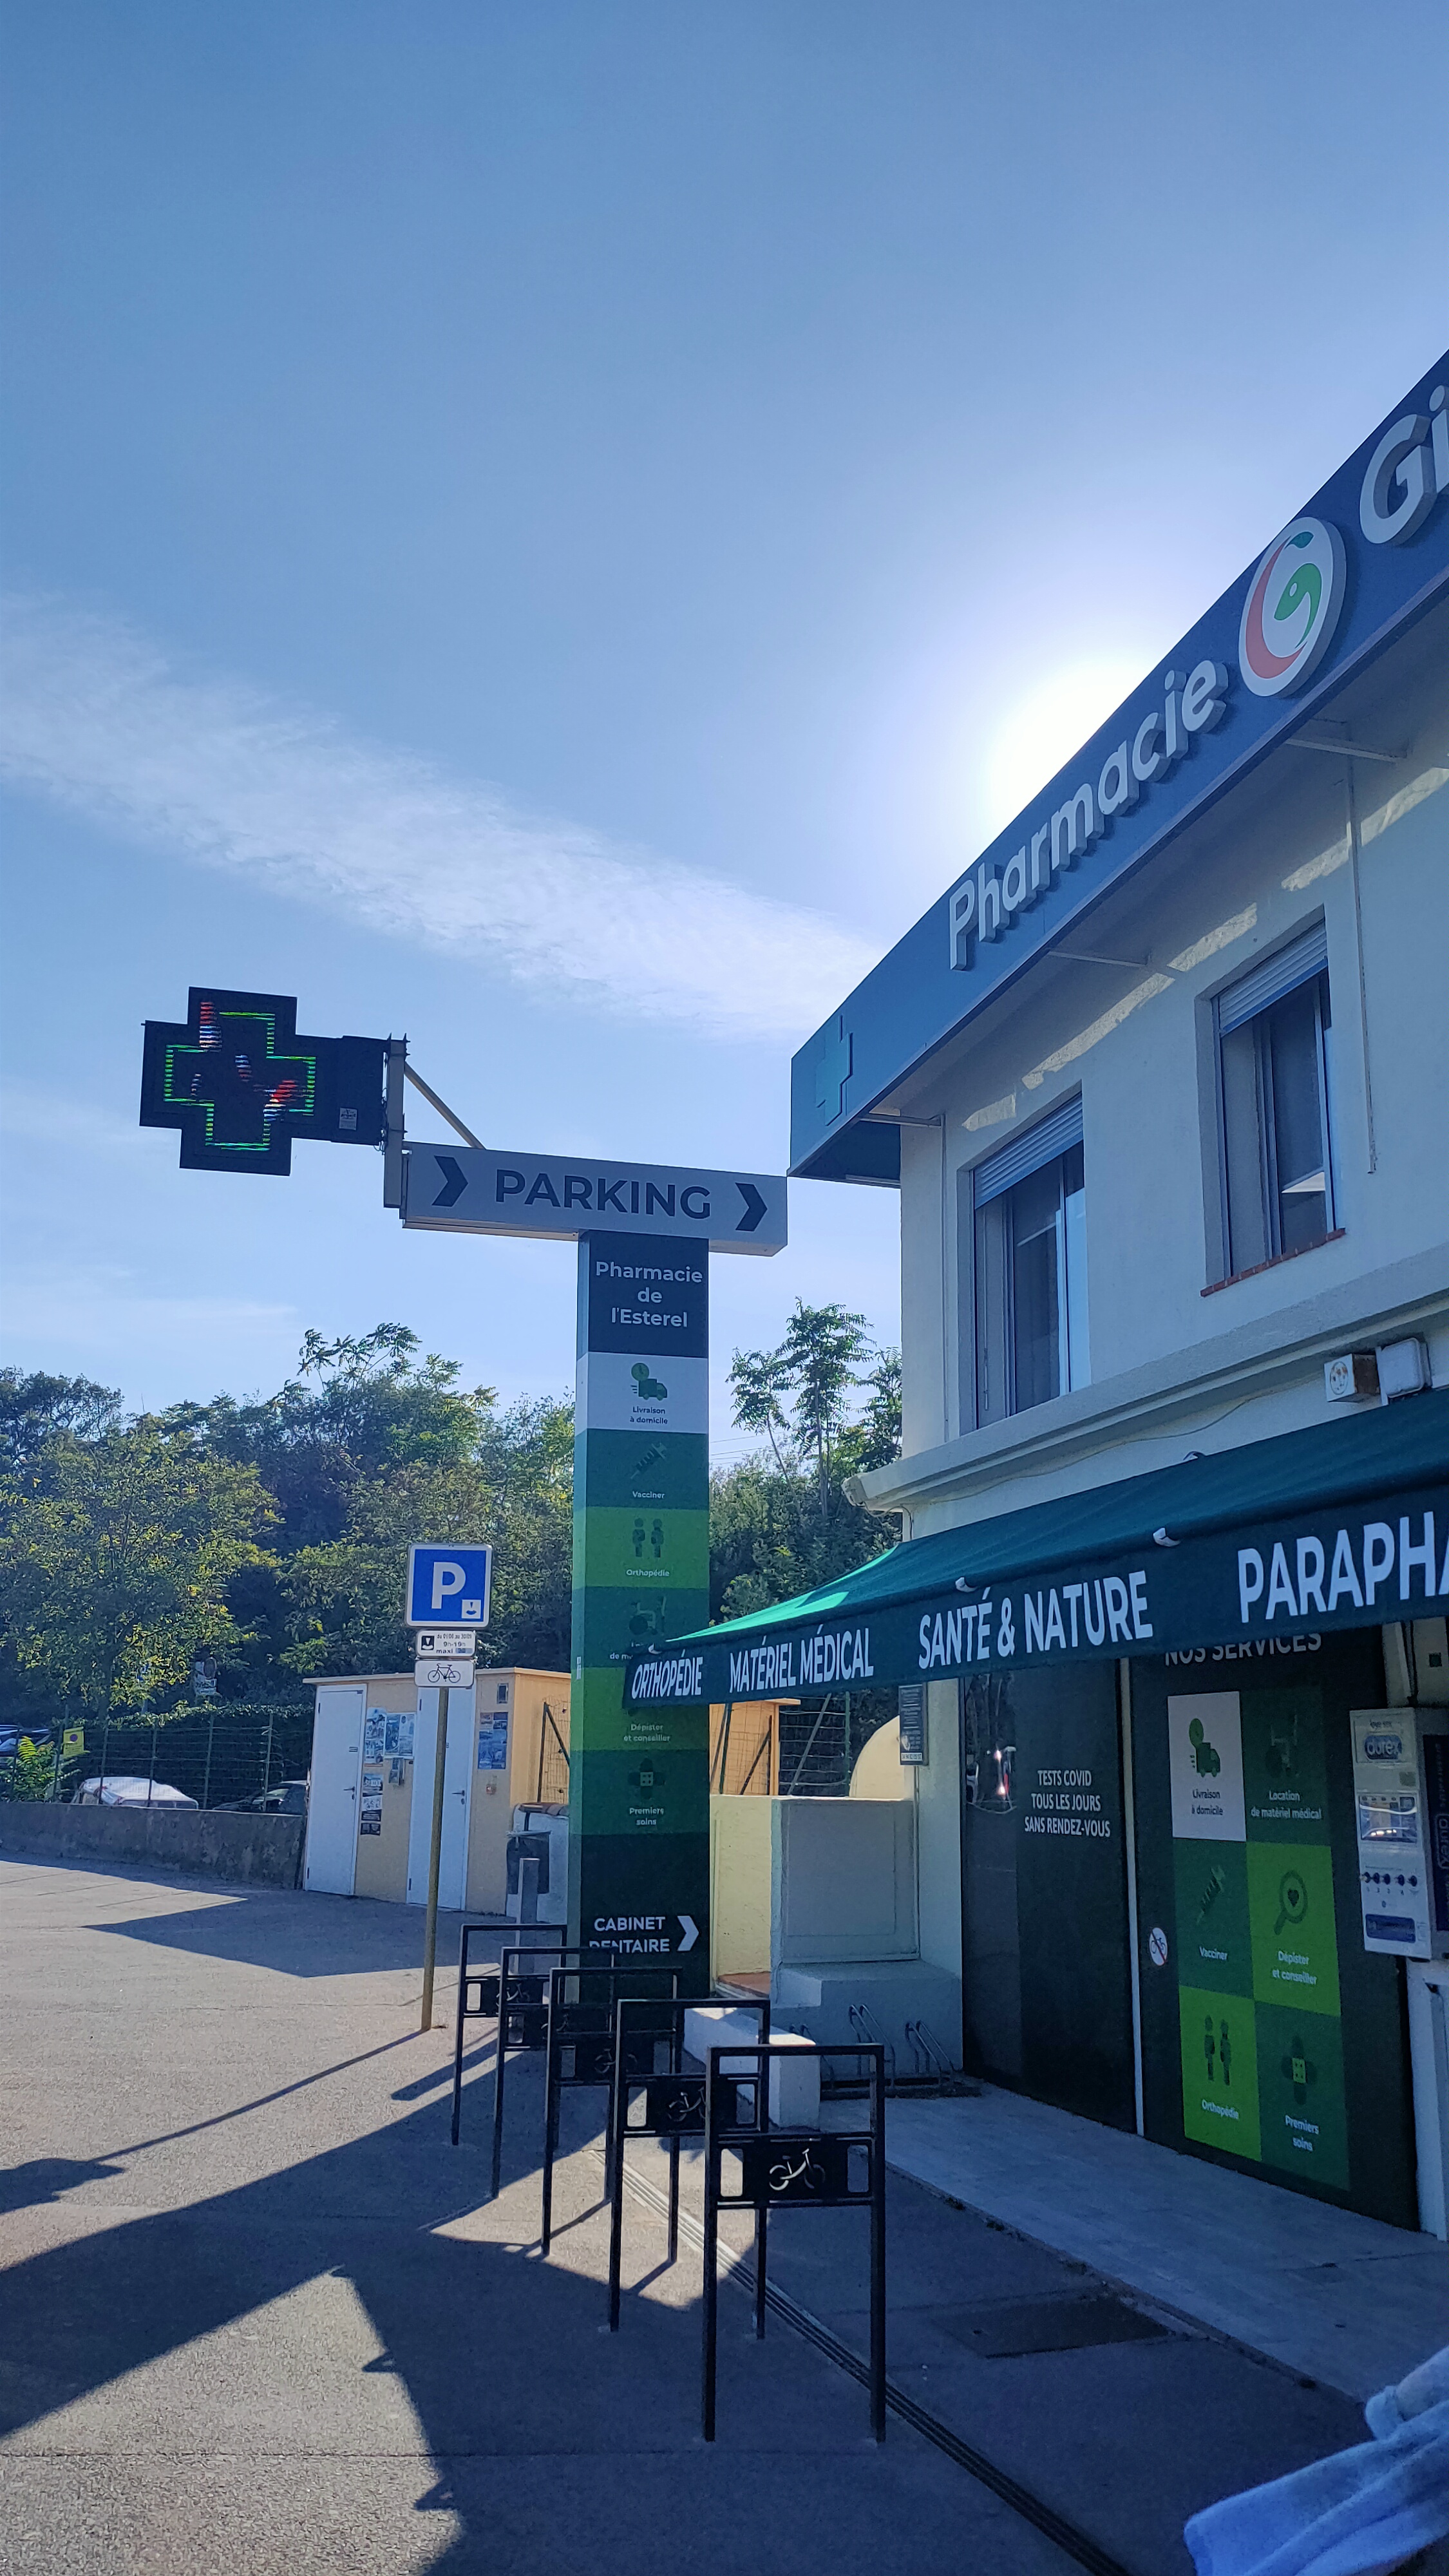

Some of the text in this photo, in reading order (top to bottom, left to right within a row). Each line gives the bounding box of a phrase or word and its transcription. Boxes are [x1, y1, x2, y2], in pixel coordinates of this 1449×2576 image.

[949, 384, 1449, 971] Pharmacie Gi
[495, 1169, 711, 1220] PARKING
[596, 1261, 703, 1283] Pharmacie
[638, 1287, 663, 1303] de
[632, 1406, 666, 1414] Livraison
[632, 1490, 665, 1499] Vacciner
[626, 1569, 670, 1578] Orthopédie
[431, 1562, 466, 1609] P
[918, 1570, 1154, 1670] SANTÉ & NATURE
[1165, 1633, 1322, 1667] NOS SERVICES
[729, 1624, 875, 1694] MATÉRIEL MÉDICAL
[631, 1649, 703, 1700] ORTHOPÉDIE
[630, 1723, 663, 1732] Dépister
[633, 1734, 670, 1742] conseiller
[1037, 1769, 1092, 1786] TESTS COVID
[1193, 1789, 1220, 1799] Livraison
[1269, 1790, 1300, 1801] Location
[1031, 1793, 1101, 1812] TOUS LES JOURS
[1197, 1804, 1224, 1815] domicile
[1251, 1806, 1322, 1819] de matériel médical
[1025, 1816, 1110, 1837] SANS RENDEZ-VOUS
[594, 1917, 665, 1931] CABINET
[1199, 1946, 1228, 1960] Vacciner
[1278, 1950, 1309, 1965] Dépister
[1273, 1969, 1317, 1985] et conseiller
[1202, 2099, 1238, 2119] Orthopédie
[1285, 2114, 1319, 2135] Premiers
[1293, 2136, 1312, 2151] soins
